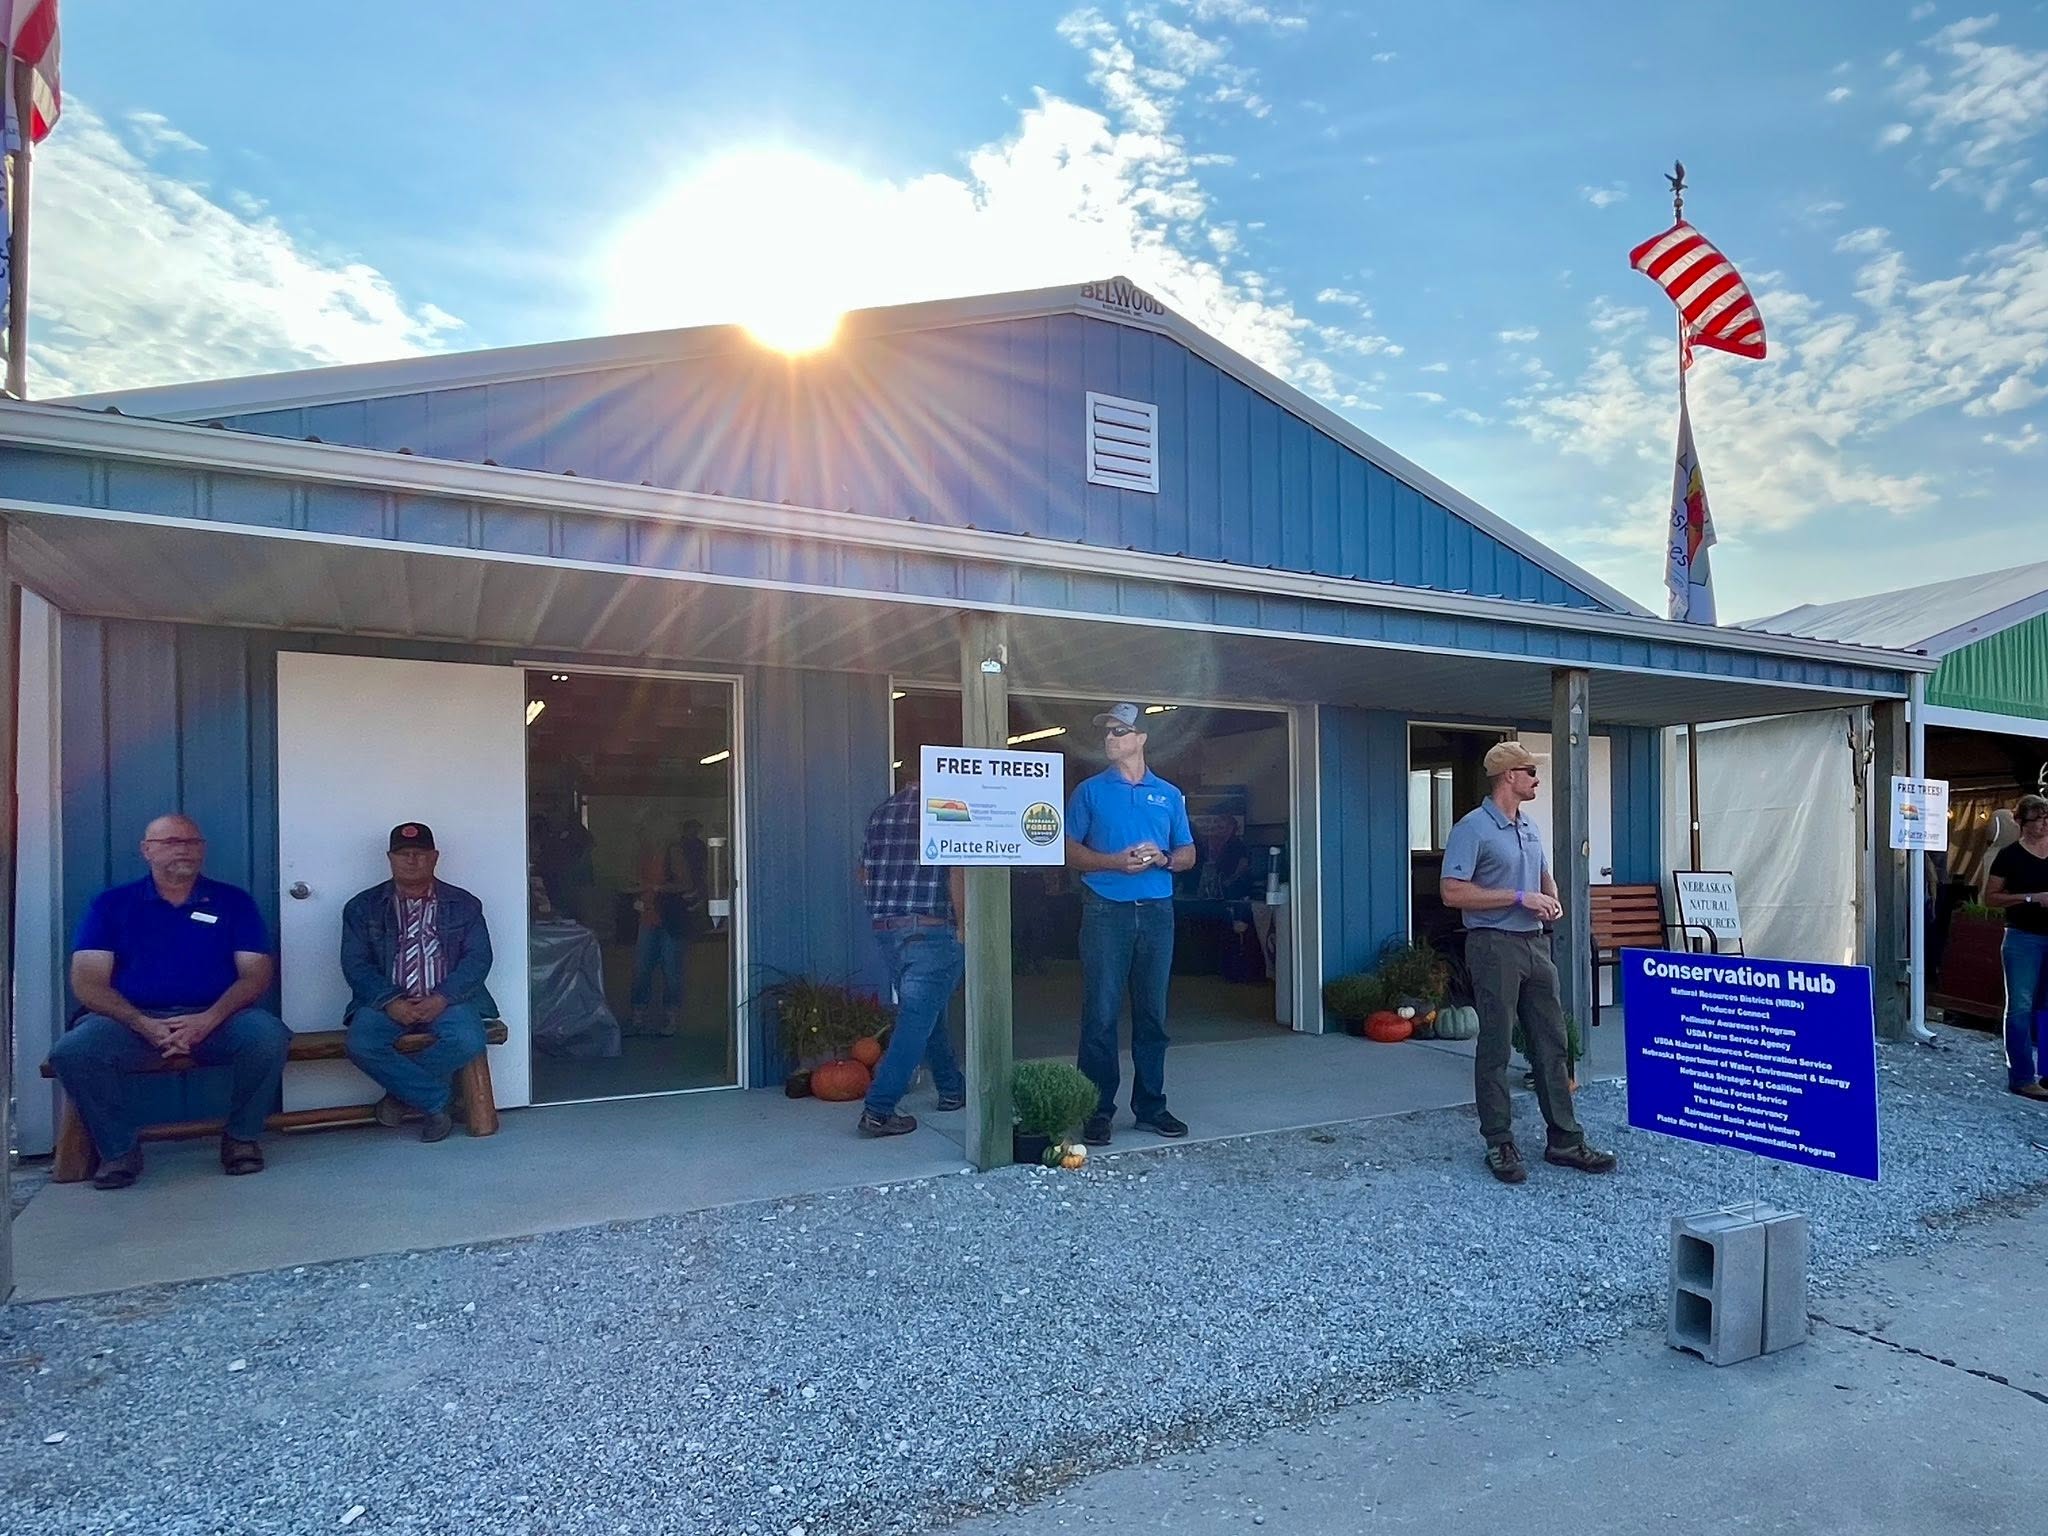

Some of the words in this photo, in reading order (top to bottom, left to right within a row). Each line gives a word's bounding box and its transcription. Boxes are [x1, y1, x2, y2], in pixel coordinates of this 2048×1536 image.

[937, 757, 982, 775] FREE
[989, 760, 1049, 778] TREES!
[1897, 783, 1916, 794] FREE
[1918, 785, 1943, 796] TREES!
[940, 840, 983, 853] Platte
[986, 840, 1022, 853] River
[1682, 880, 1732, 894] NEBRASKA'S
[1689, 899, 1730, 911] NATURAL
[1688, 917, 1737, 929] RESOURCES
[1643, 957, 1780, 989] Conservation
[1787, 970, 1836, 994] Hub
[1671, 987, 1697, 997] Natural
[1699, 990, 1738, 1002] Resources
[1739, 994, 1773, 1006] Districts
[1775, 998, 1804, 1011] (NRDs)
[1701, 1003, 1736, 1015] Producer
[1737, 1008, 1770, 1020] Connect
[1680, 1014, 1716, 1026] Pollinator
[1717, 1019, 1759, 1032] Awareness
[1761, 1024, 1796, 1037] Program
[1686, 1028, 1707, 1038] USDA
[1708, 1031, 1728, 1041] Farm
[1729, 1034, 1759, 1046] Service
[1760, 1038, 1791, 1052] Agency
[1654, 1036, 1674, 1046] USDA
[1675, 1039, 1702, 1050] Natural
[1703, 1043, 1743, 1057] Resources
[1744, 1050, 1798, 1065] Conservation
[1799, 1058, 1833, 1070] Service
[1642, 1047, 1675, 1059] Nebraska
[1675, 1053, 1719, 1067] Department
[1719, 1060, 1728, 1068] of
[1729, 1061, 1755, 1074] Water,
[1756, 1065, 1808, 1081] Environment
[1809, 1074, 1817, 1082] &
[1818, 1075, 1850, 1089] Energy
[1680, 1066, 1714, 1079] Nebraska
[1716, 1072, 1751, 1086] Strategic
[1753, 1079, 1764, 1089] Ag
[1765, 1081, 1803, 1094] Coalition
[1693, 1081, 1729, 1095] Nebraska
[1730, 1088, 1755, 1100] Forest
[1757, 1093, 1788, 1106] Service
[1694, 1095, 1708, 1104] The
[1709, 1097, 1736, 1109] Nature
[1737, 1103, 1788, 1121] Conservancy
[1684, 1106, 1722, 1120] Rainwater
[1723, 1113, 1745, 1125] Basin
[1746, 1119, 1766, 1129] Joint
[1768, 1123, 1800, 1136] Venture
[1657, 1113, 1678, 1125] Platte
[1679, 1118, 1697, 1129] River
[1698, 1122, 1734, 1138] Recovery
[1735, 1130, 1797, 1150] Implementation
[1799, 1143, 1836, 1158] Program
